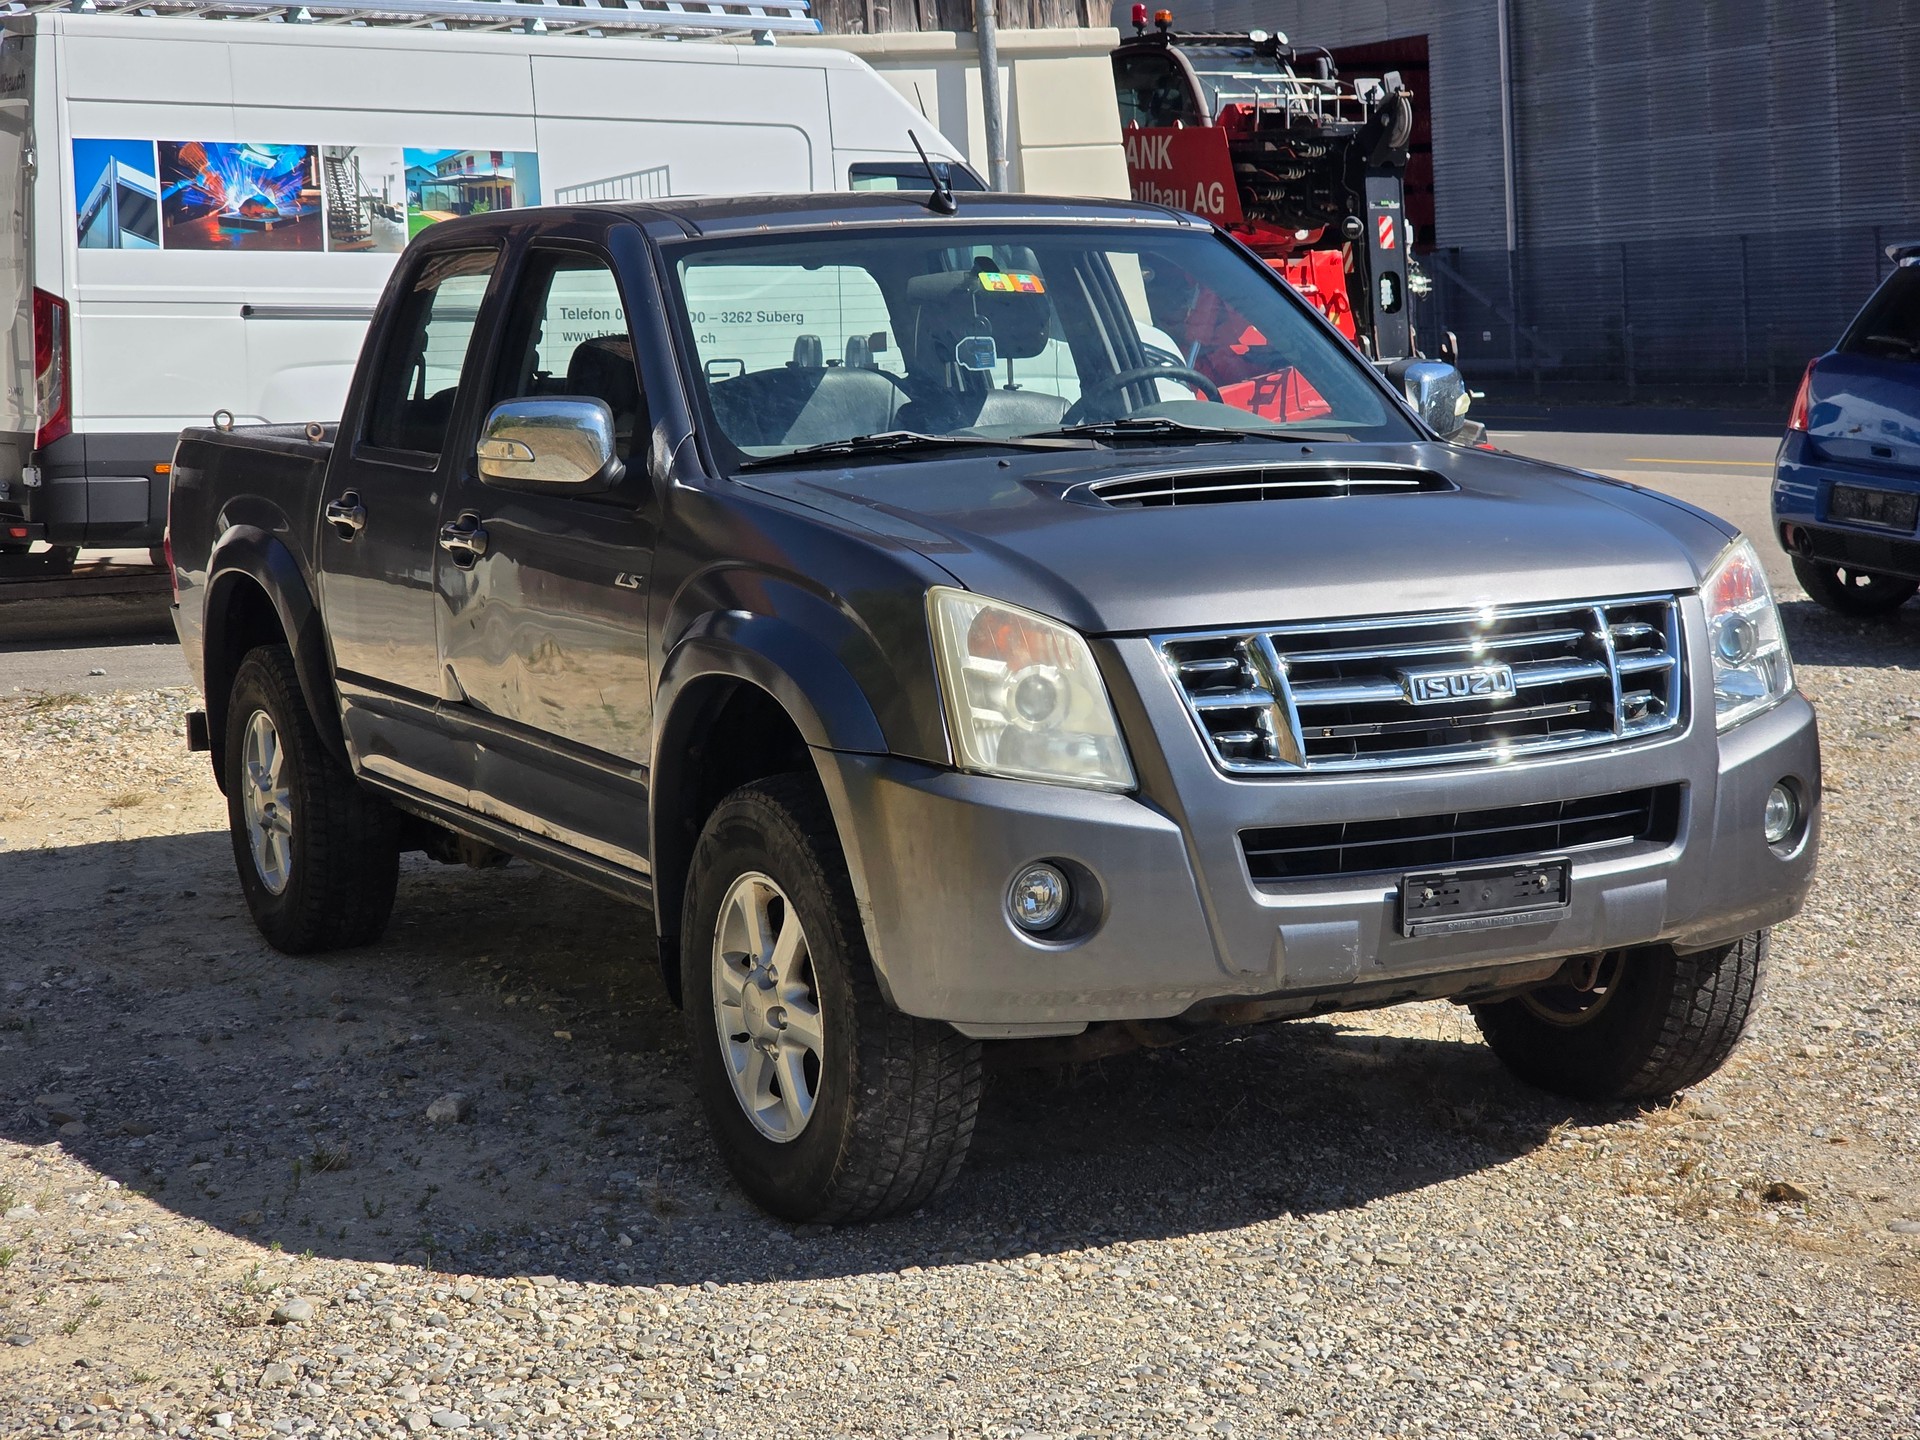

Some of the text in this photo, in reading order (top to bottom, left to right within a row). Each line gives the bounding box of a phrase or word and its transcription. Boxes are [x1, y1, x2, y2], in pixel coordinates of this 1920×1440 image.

[1126, 135, 1173, 170] ANK
[1192, 181, 1225, 214] AG
[560, 307, 610, 321] Telefon
[721, 311, 752, 323] 3262
[756, 311, 804, 325] Suberg
[614, 571, 643, 589] LS
[1417, 671, 1511, 700] ISUZU
